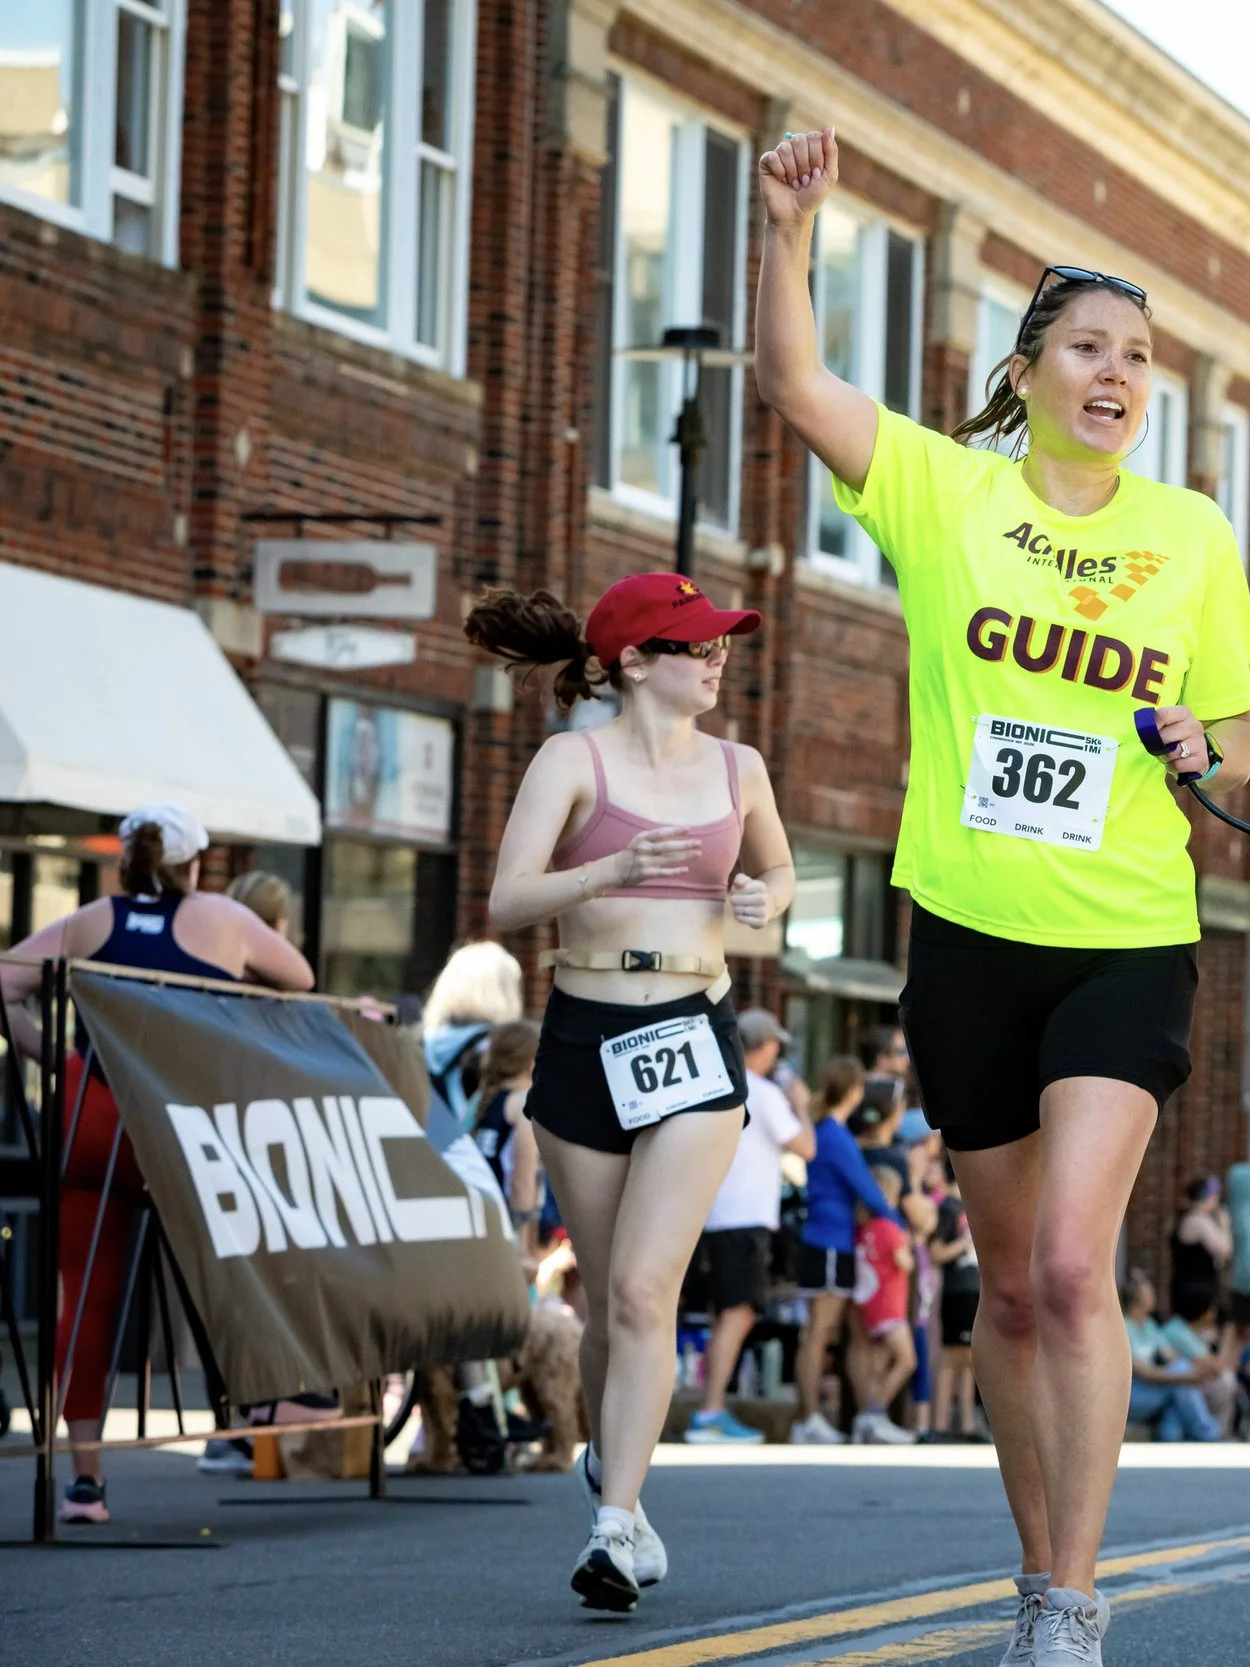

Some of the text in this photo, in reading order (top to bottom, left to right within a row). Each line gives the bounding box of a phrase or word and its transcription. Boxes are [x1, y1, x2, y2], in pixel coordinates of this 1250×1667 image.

[966, 606, 1170, 706] GUIDE
[990, 720, 1085, 751] BIONIC
[991, 747, 1086, 810] 362
[969, 814, 1092, 844] FOOD DRINK DRINK
[611, 1022, 685, 1055] BIONIC
[630, 1040, 700, 1093] 621
[166, 1096, 474, 1259] BIONIC
